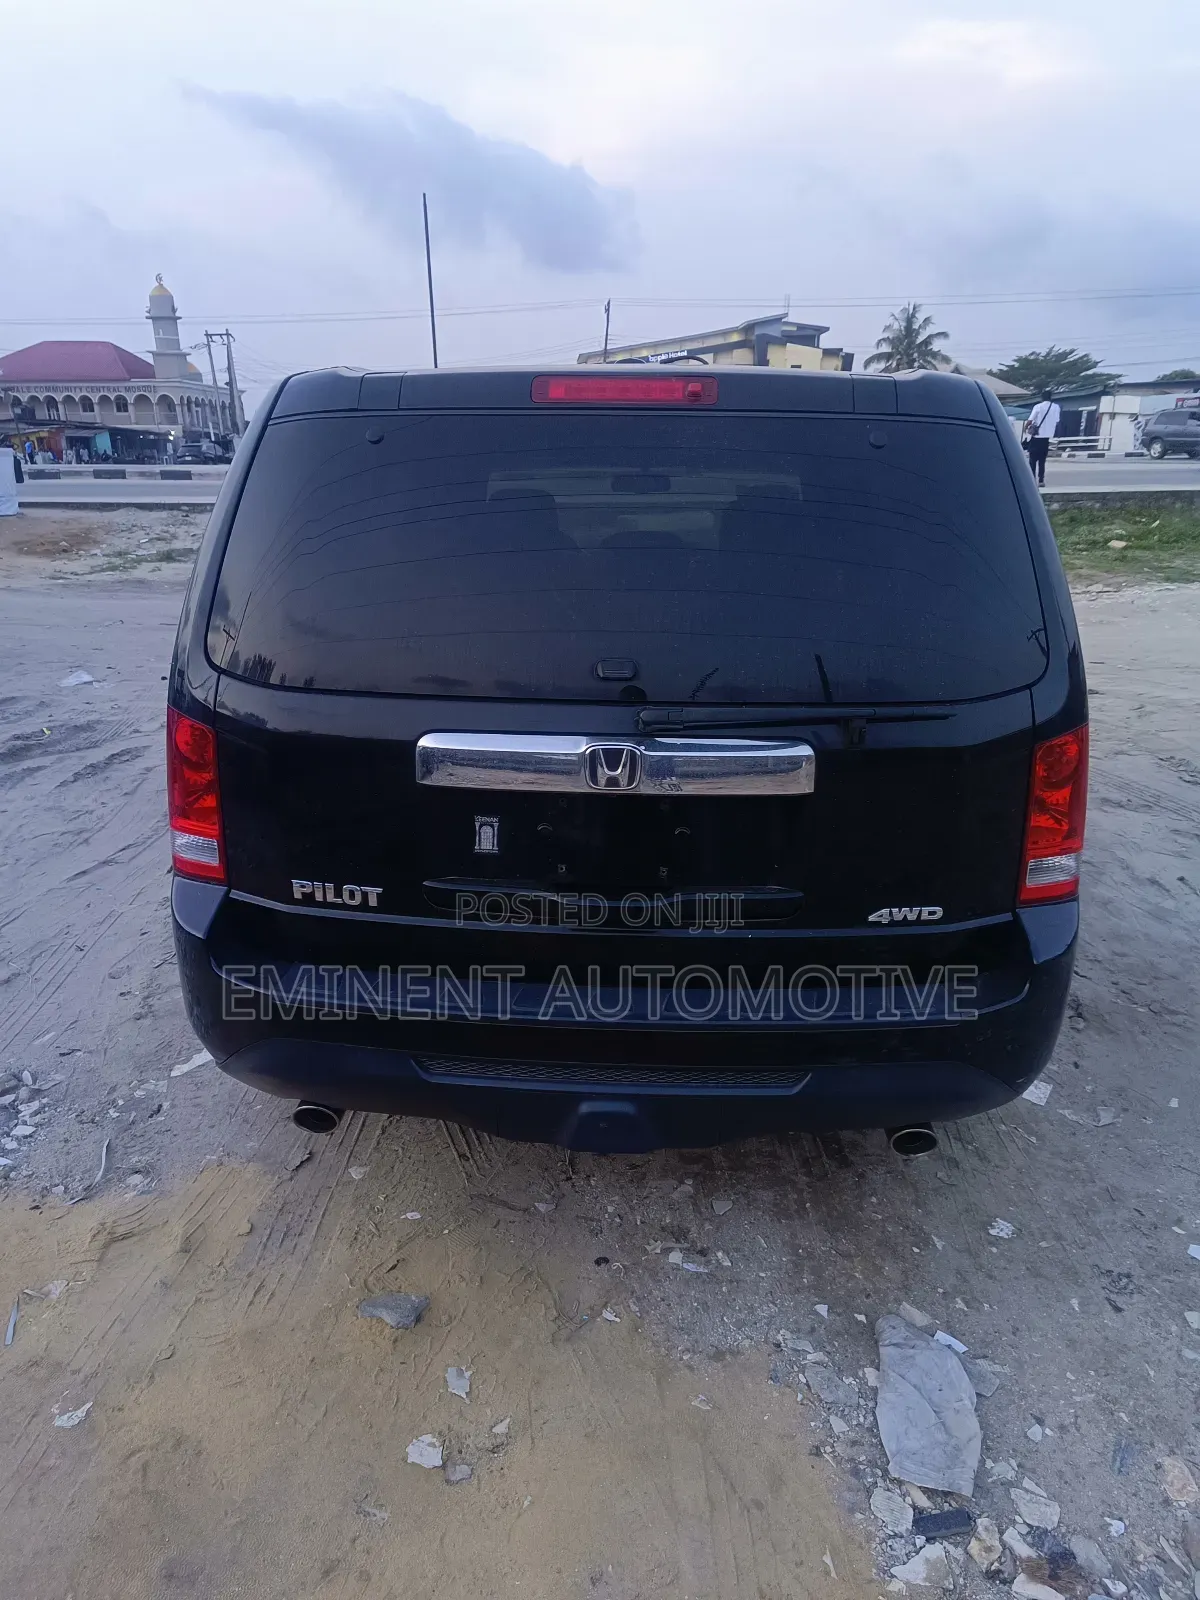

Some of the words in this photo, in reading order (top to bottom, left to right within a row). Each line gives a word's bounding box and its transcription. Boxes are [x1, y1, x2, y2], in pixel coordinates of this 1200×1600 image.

[669, 350, 687, 358] Hotel
[33, 385, 83, 393] COMMUNITY
[85, 385, 122, 393] CENTRAL
[124, 385, 157, 393] MOSQUE
[291, 879, 384, 907] PILOT
[867, 906, 944, 924] 4WD
